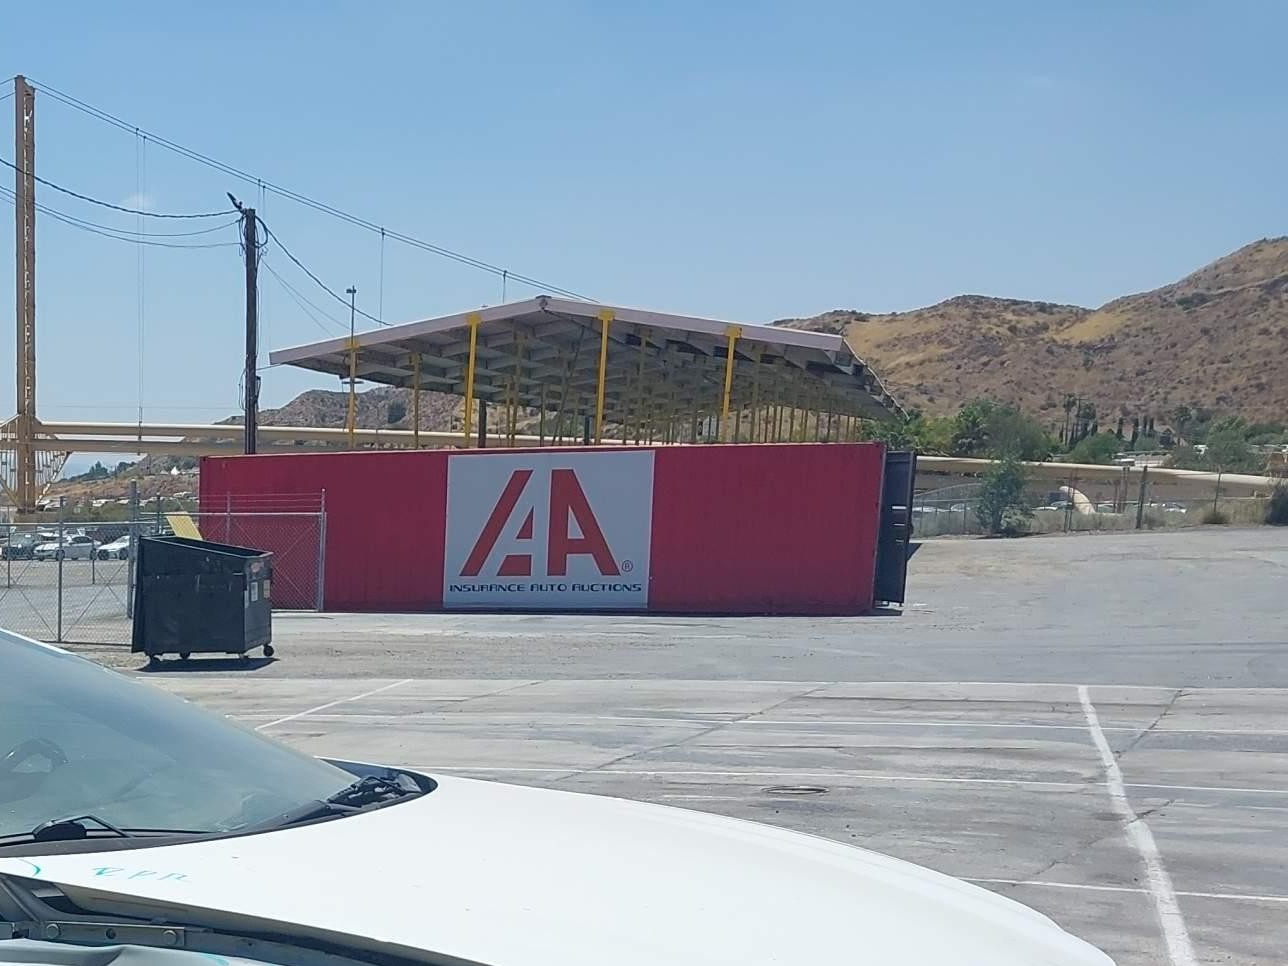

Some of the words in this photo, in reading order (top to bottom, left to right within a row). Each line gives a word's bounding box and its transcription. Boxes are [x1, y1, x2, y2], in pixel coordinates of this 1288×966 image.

[448, 583, 526, 592] INSURANCE
[530, 583, 568, 592] AUTO
[571, 583, 643, 592] AUCTIONS
